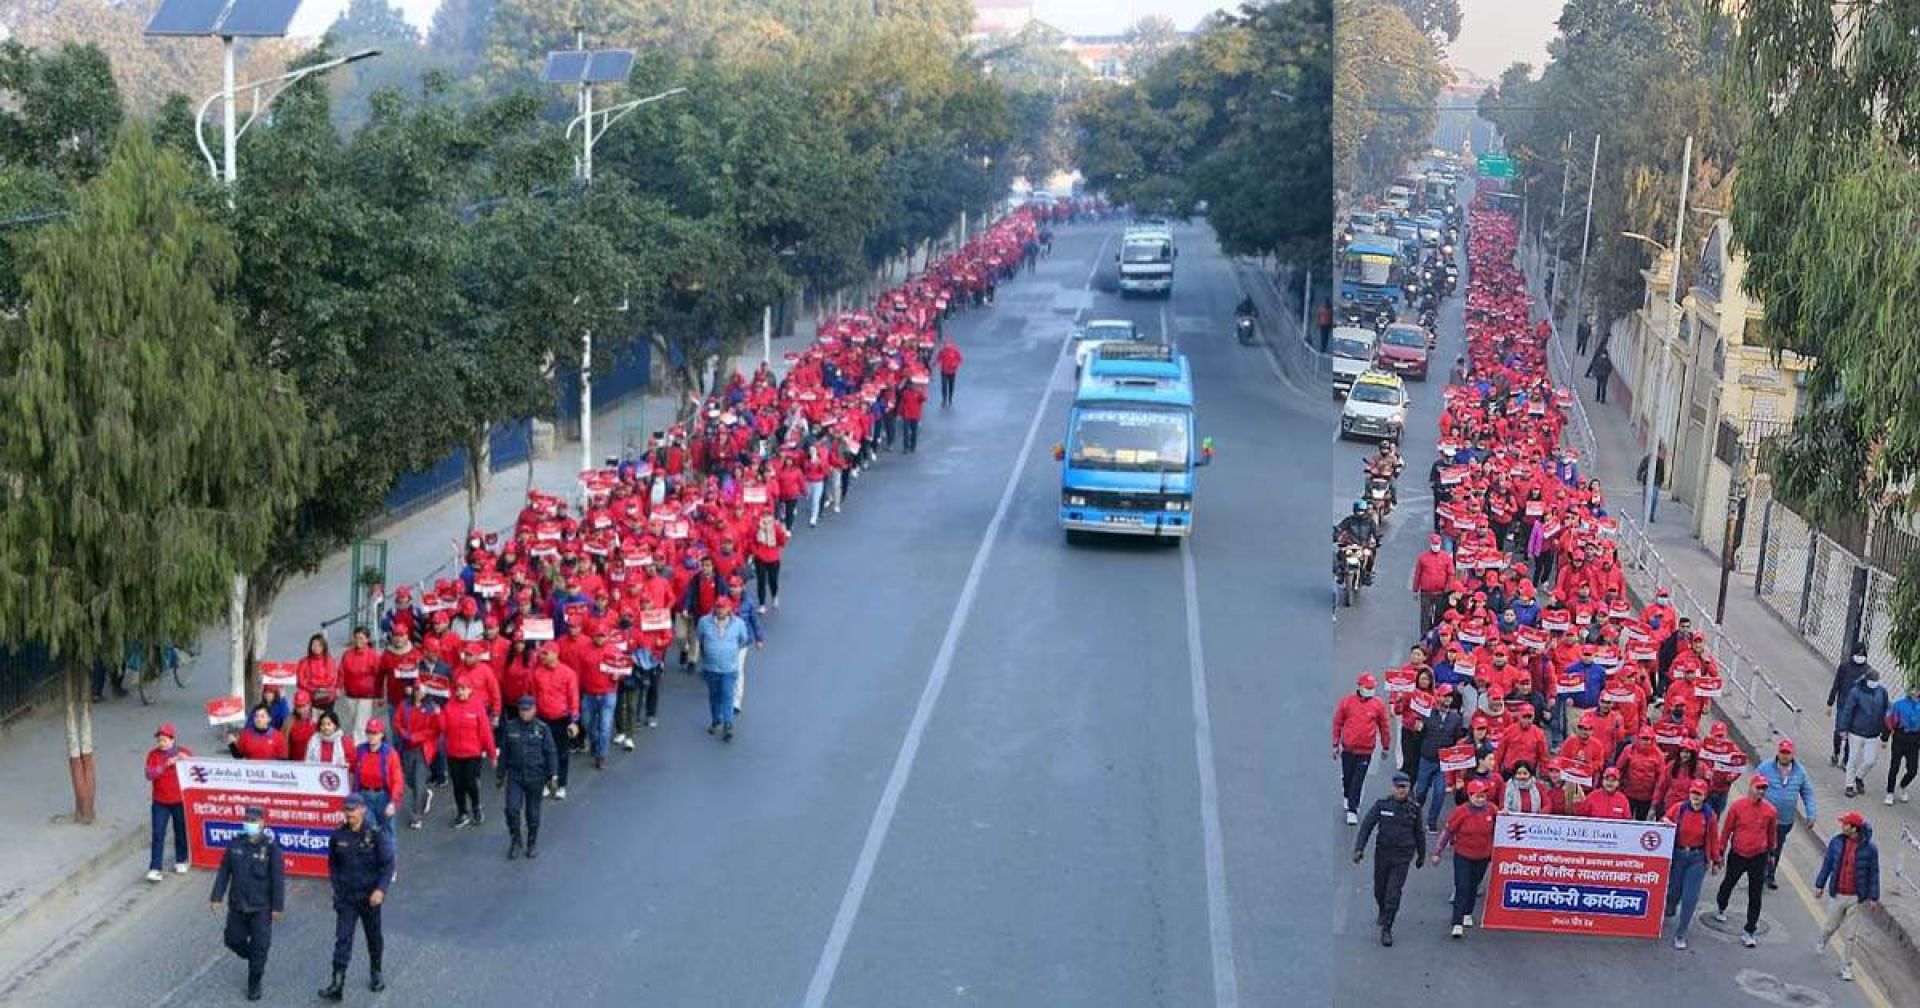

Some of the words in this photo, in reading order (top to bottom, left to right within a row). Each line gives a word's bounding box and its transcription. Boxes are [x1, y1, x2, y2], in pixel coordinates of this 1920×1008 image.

[208, 768, 242, 778] Global
[245, 767, 265, 778] IME
[271, 769, 297, 780] Bank
[1528, 824, 1562, 837] Global
[1566, 826, 1589, 838] IME
[1593, 827, 1618, 840] Bank
[1499, 862, 1541, 875] डिजिटल
[1543, 863, 1577, 878] वित्तीय
[1633, 870, 1660, 884] लागि
[1510, 886, 1580, 907] प्रभातफेरी
[1582, 890, 1642, 911] कार्यक्रम
